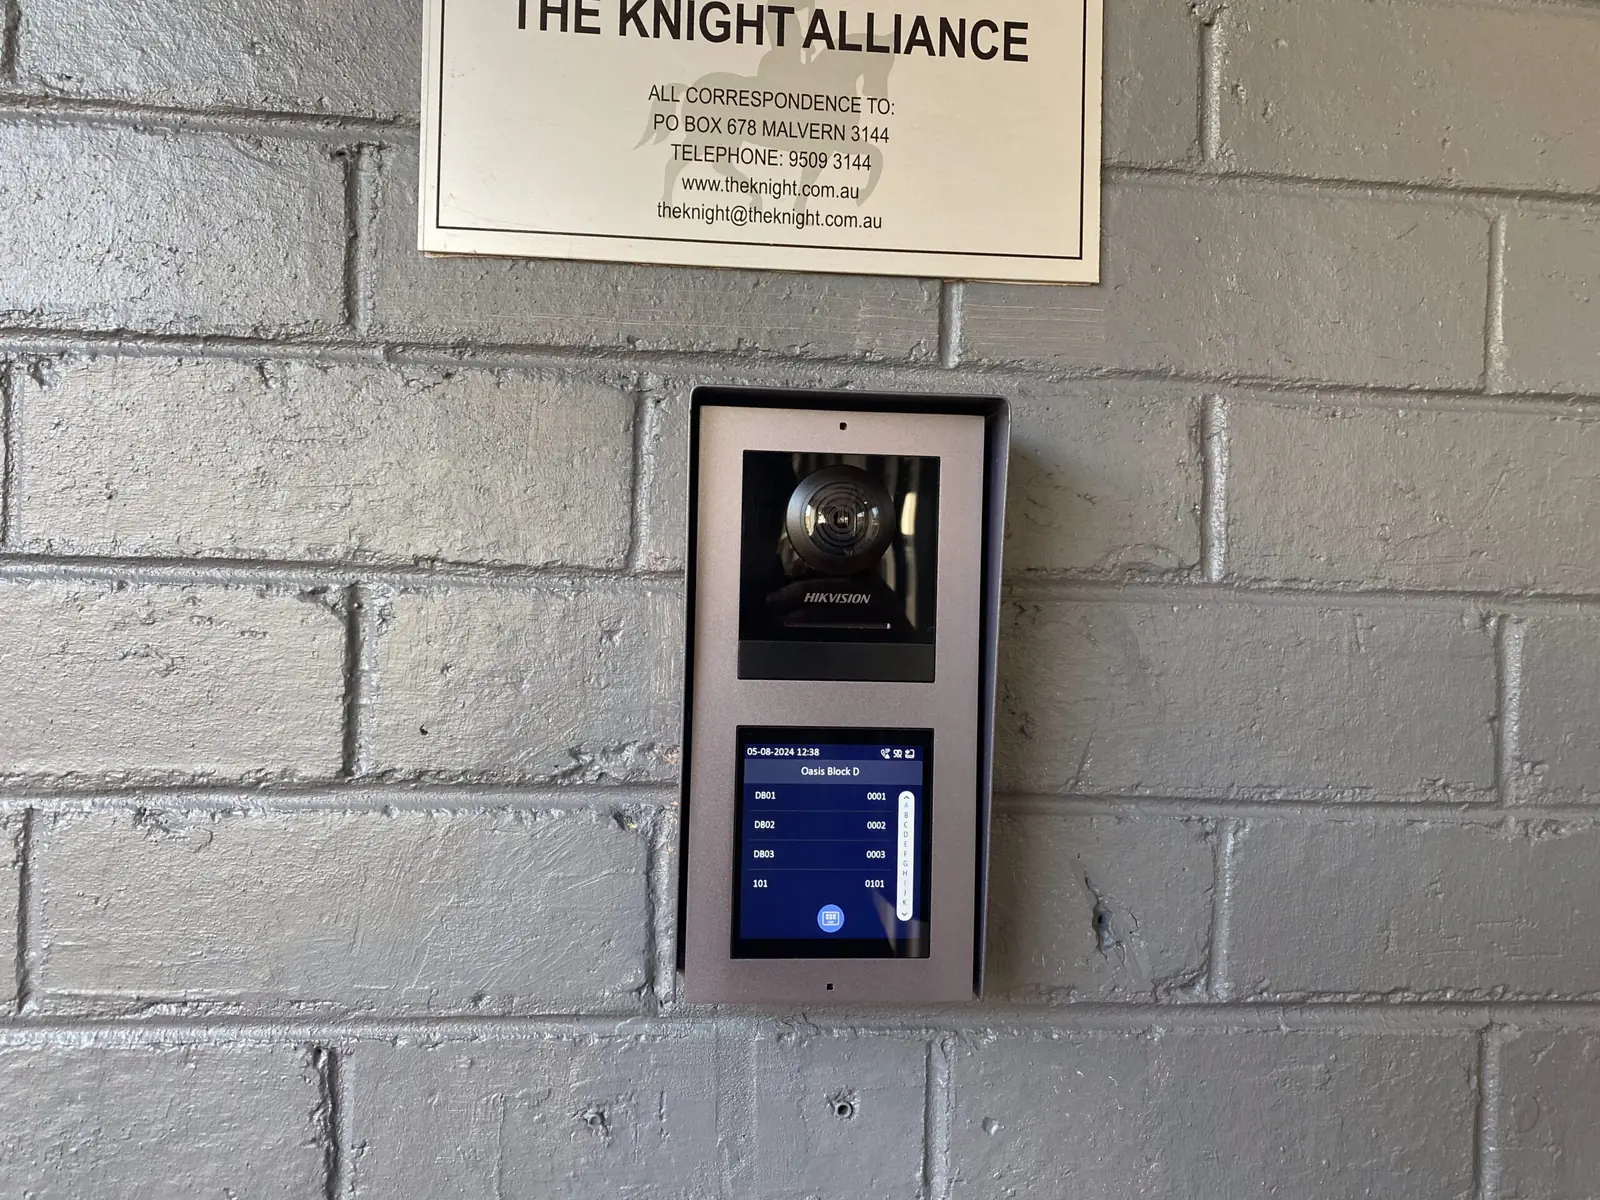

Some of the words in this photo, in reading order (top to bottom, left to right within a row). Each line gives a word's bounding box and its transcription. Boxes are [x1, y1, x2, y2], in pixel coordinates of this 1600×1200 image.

[619, 0, 794, 46] KNIGHT
[802, 9, 1028, 62] ALLIANCE
[648, 84, 680, 103] ALL
[685, 86, 862, 114] CORRESPONDENCE
[866, 97, 895, 116] TO:
[653, 113, 679, 132] PO
[684, 115, 722, 134] BOX
[727, 117, 757, 136] 678
[762, 119, 846, 142] MALVERN
[850, 125, 890, 144] 3144
[670, 143, 783, 167] TELEPHONE:
[788, 150, 828, 169] 9509
[833, 152, 872, 171] 3144
[681, 175, 859, 200] www.theknight.com.au
[657, 201, 882, 230] theknight@theknight.com.au
[803, 592, 871, 604] HIKVISION
[746, 747, 795, 756] 05-08-2024
[796, 747, 820, 757] 12:38
[800, 766, 826, 776] Oasis
[827, 766, 851, 776] Block
[852, 766, 860, 776] D
[755, 791, 776, 800] DB01
[866, 791, 887, 801] 0001
[754, 820, 775, 829] DB02
[866, 820, 886, 830] 0002
[753, 849, 775, 859] DB03
[866, 850, 886, 859] 0003
[753, 879, 768, 888] 101
[864, 879, 885, 888] 0101
